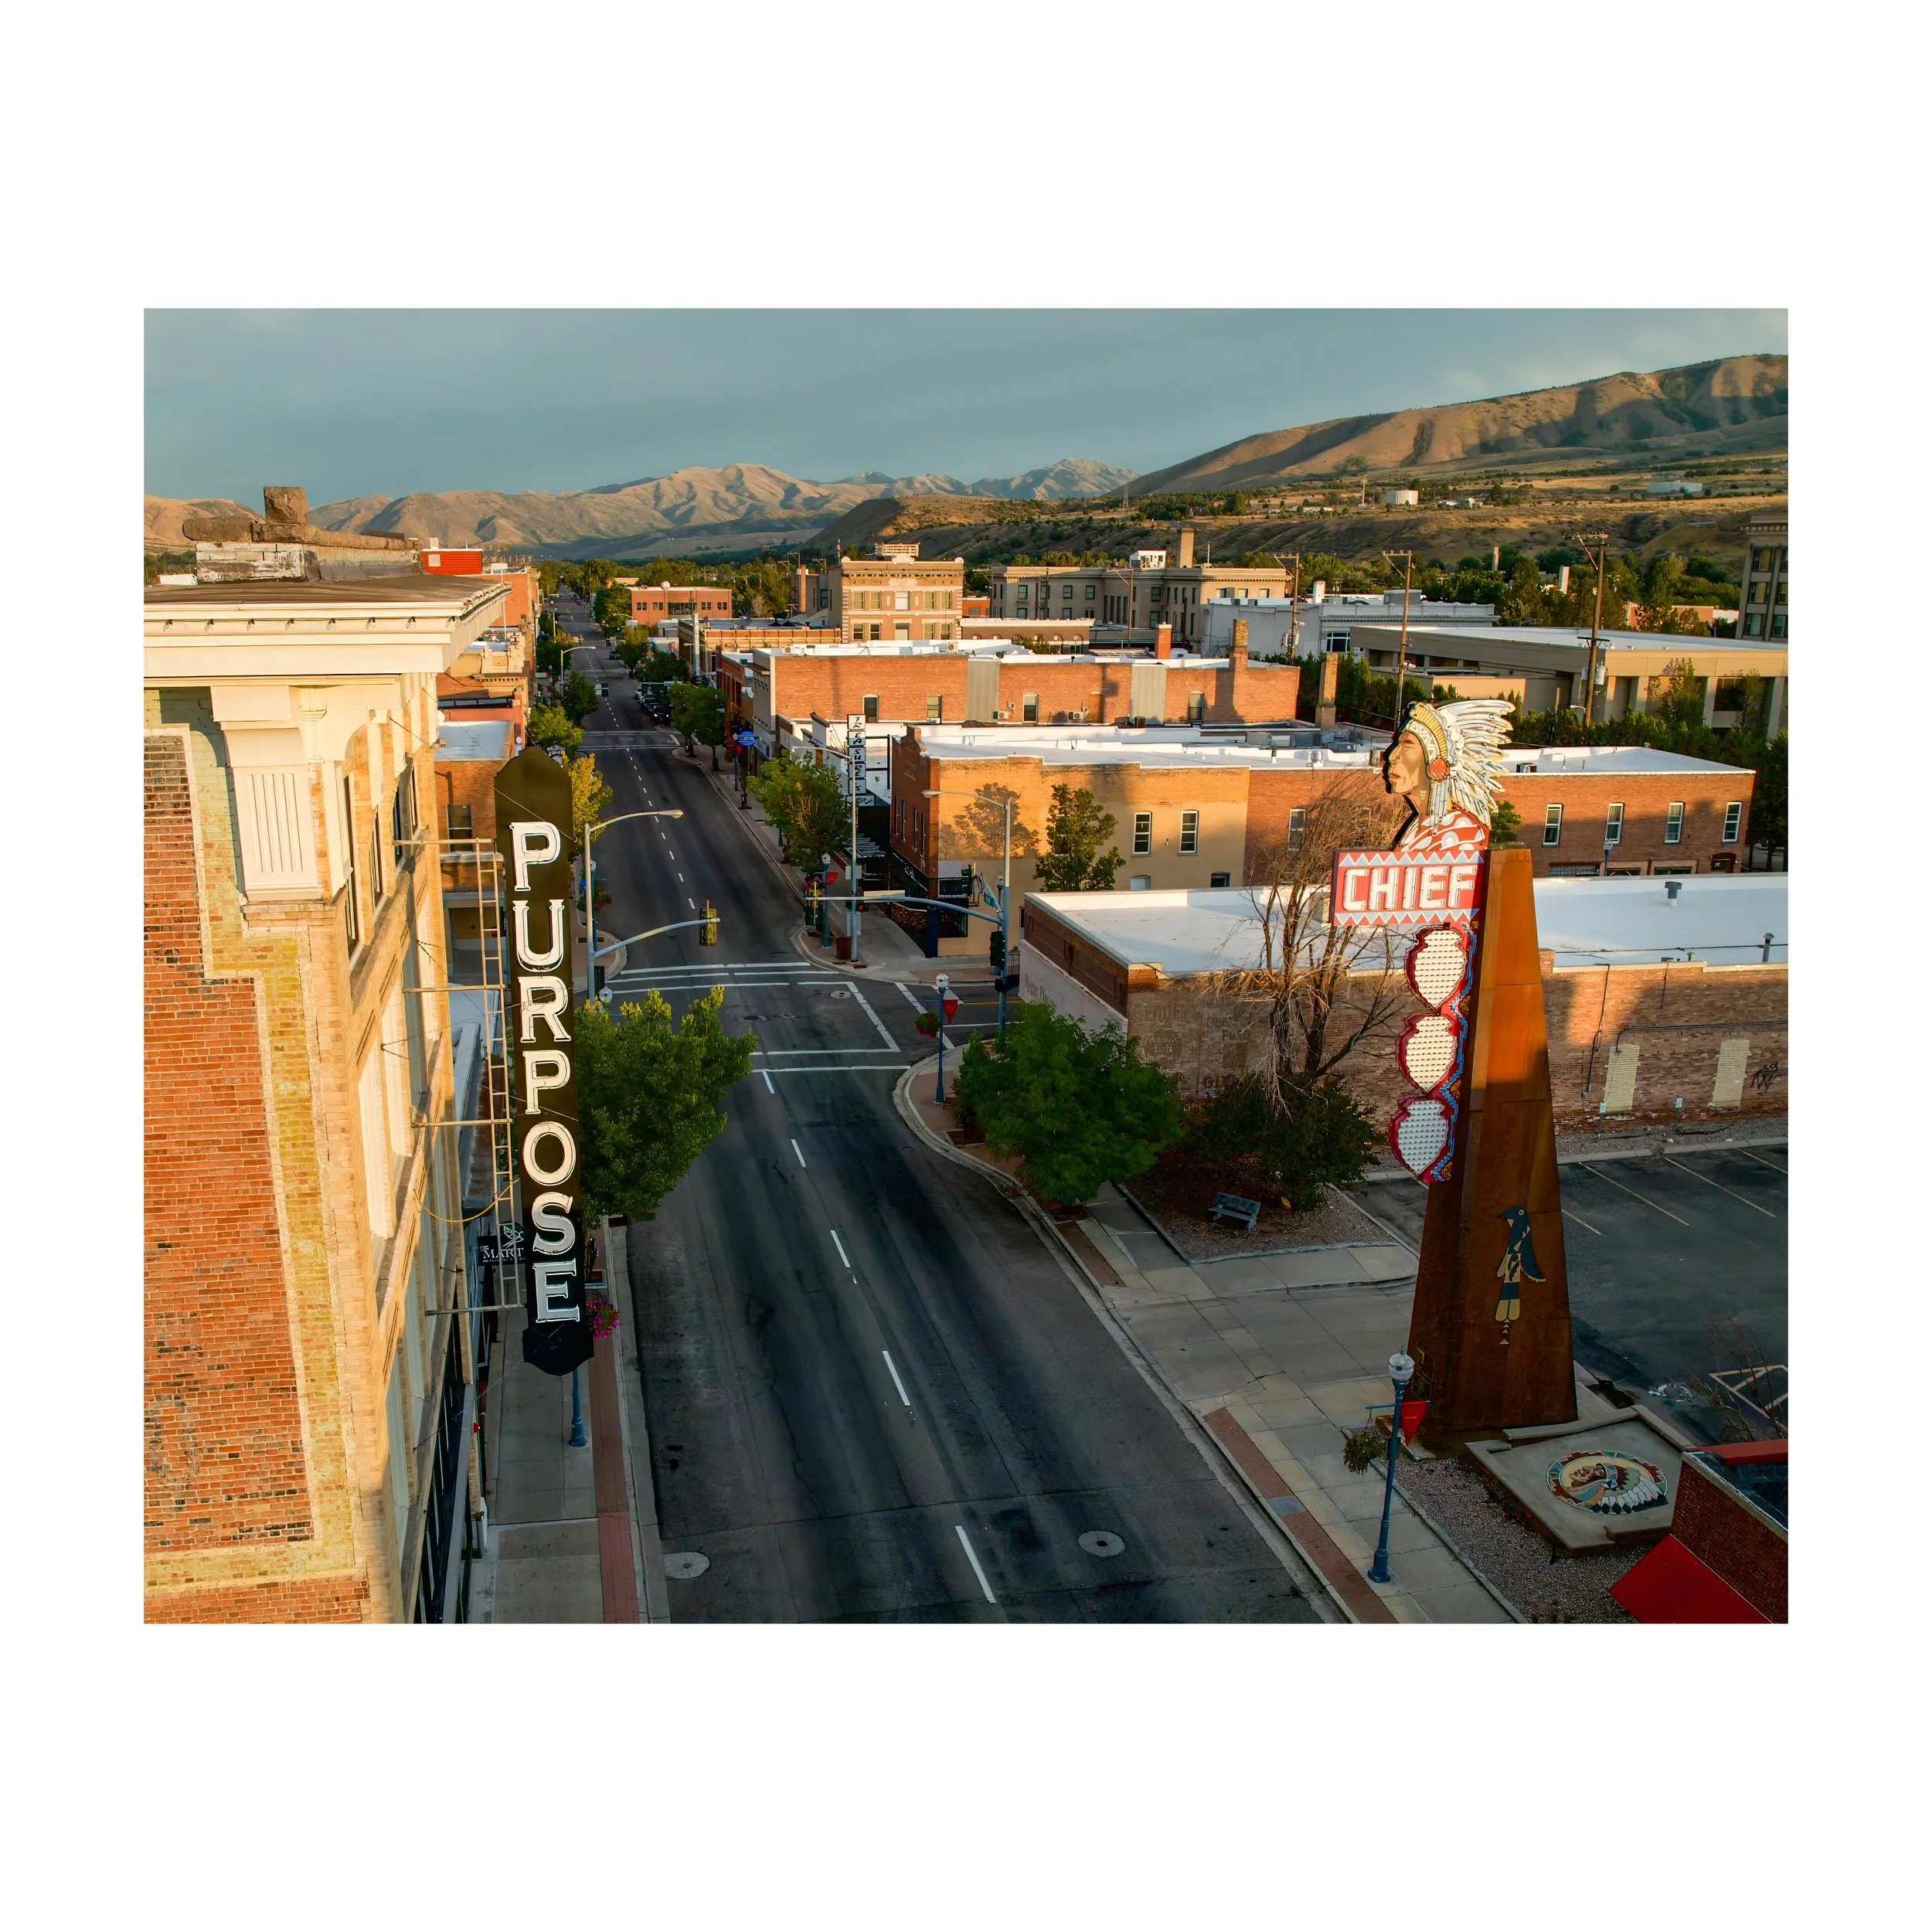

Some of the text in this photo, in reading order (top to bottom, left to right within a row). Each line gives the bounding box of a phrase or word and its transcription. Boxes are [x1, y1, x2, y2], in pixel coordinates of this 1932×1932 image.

[1342, 866, 1478, 910] CHIEF
[509, 821, 580, 1324] PURPOSE
[483, 1247, 524, 1259] MART
